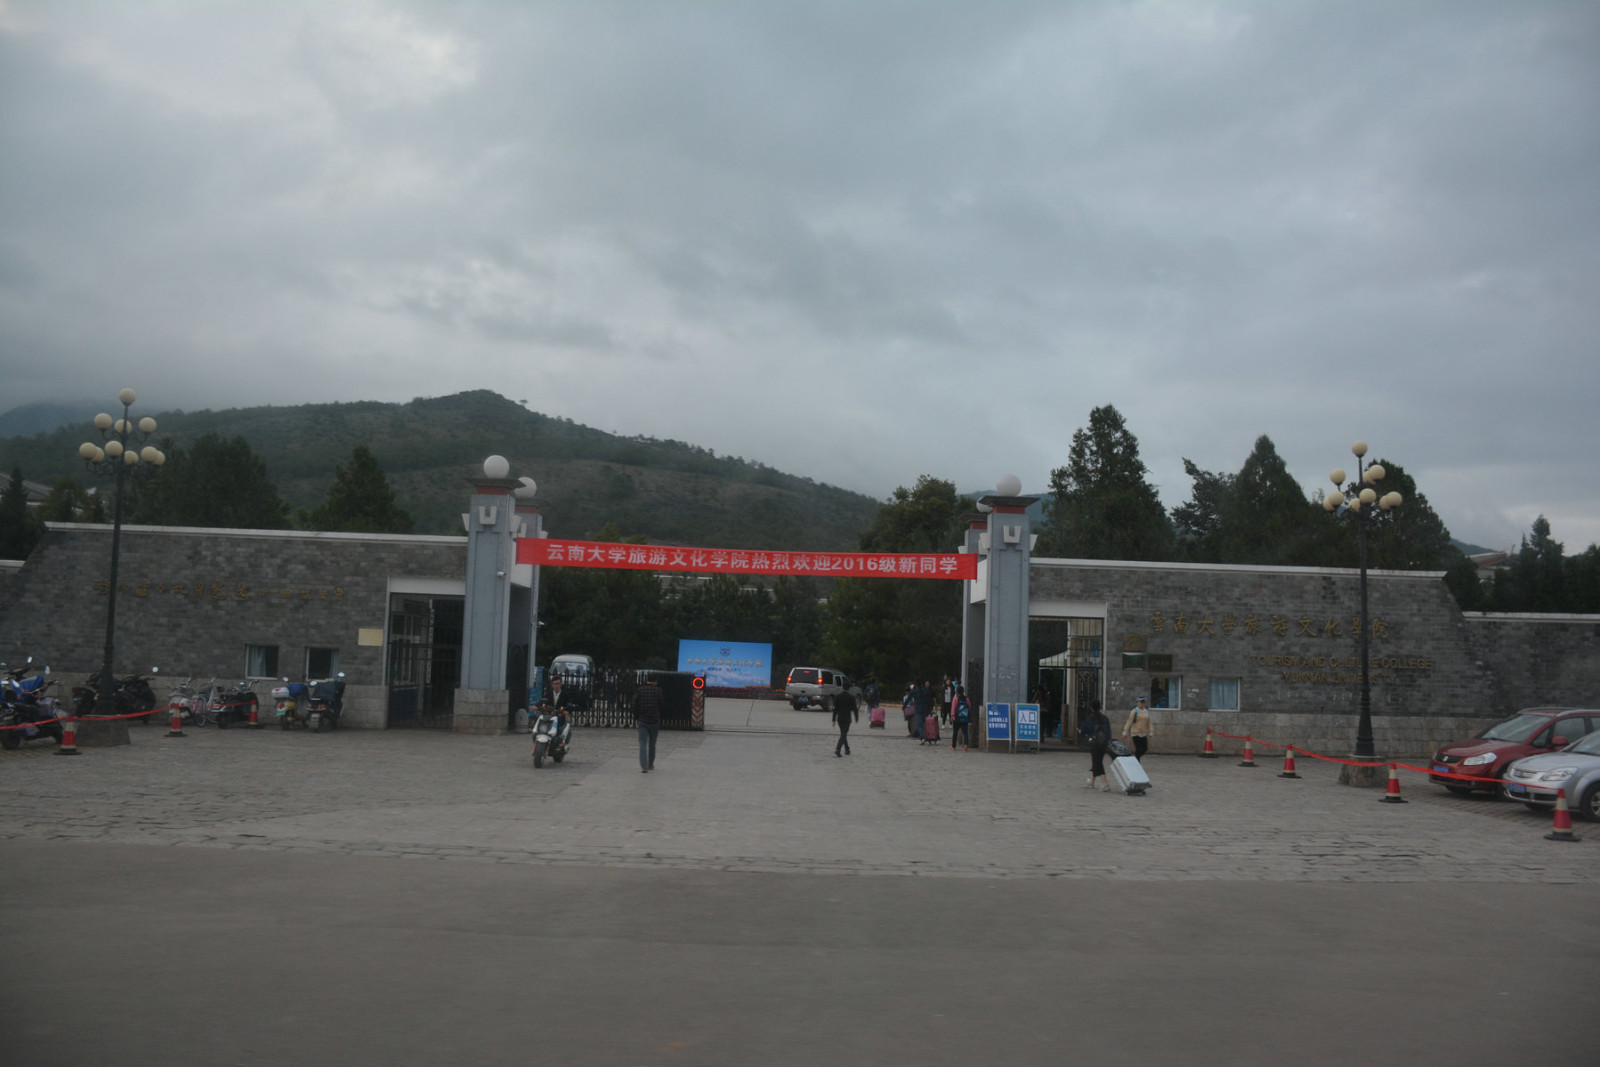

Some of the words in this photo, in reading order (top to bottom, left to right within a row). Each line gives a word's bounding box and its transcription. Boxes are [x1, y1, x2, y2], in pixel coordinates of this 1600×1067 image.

[546, 543, 958, 574] 云南大学旅游文化学院热烈欢迎2016级新同学
[1249, 654, 1300, 667] TOURISM
[1303, 656, 1327, 668] AND
[1381, 657, 1433, 670] COLLEGE
[1282, 671, 1330, 683] YUNNAN
